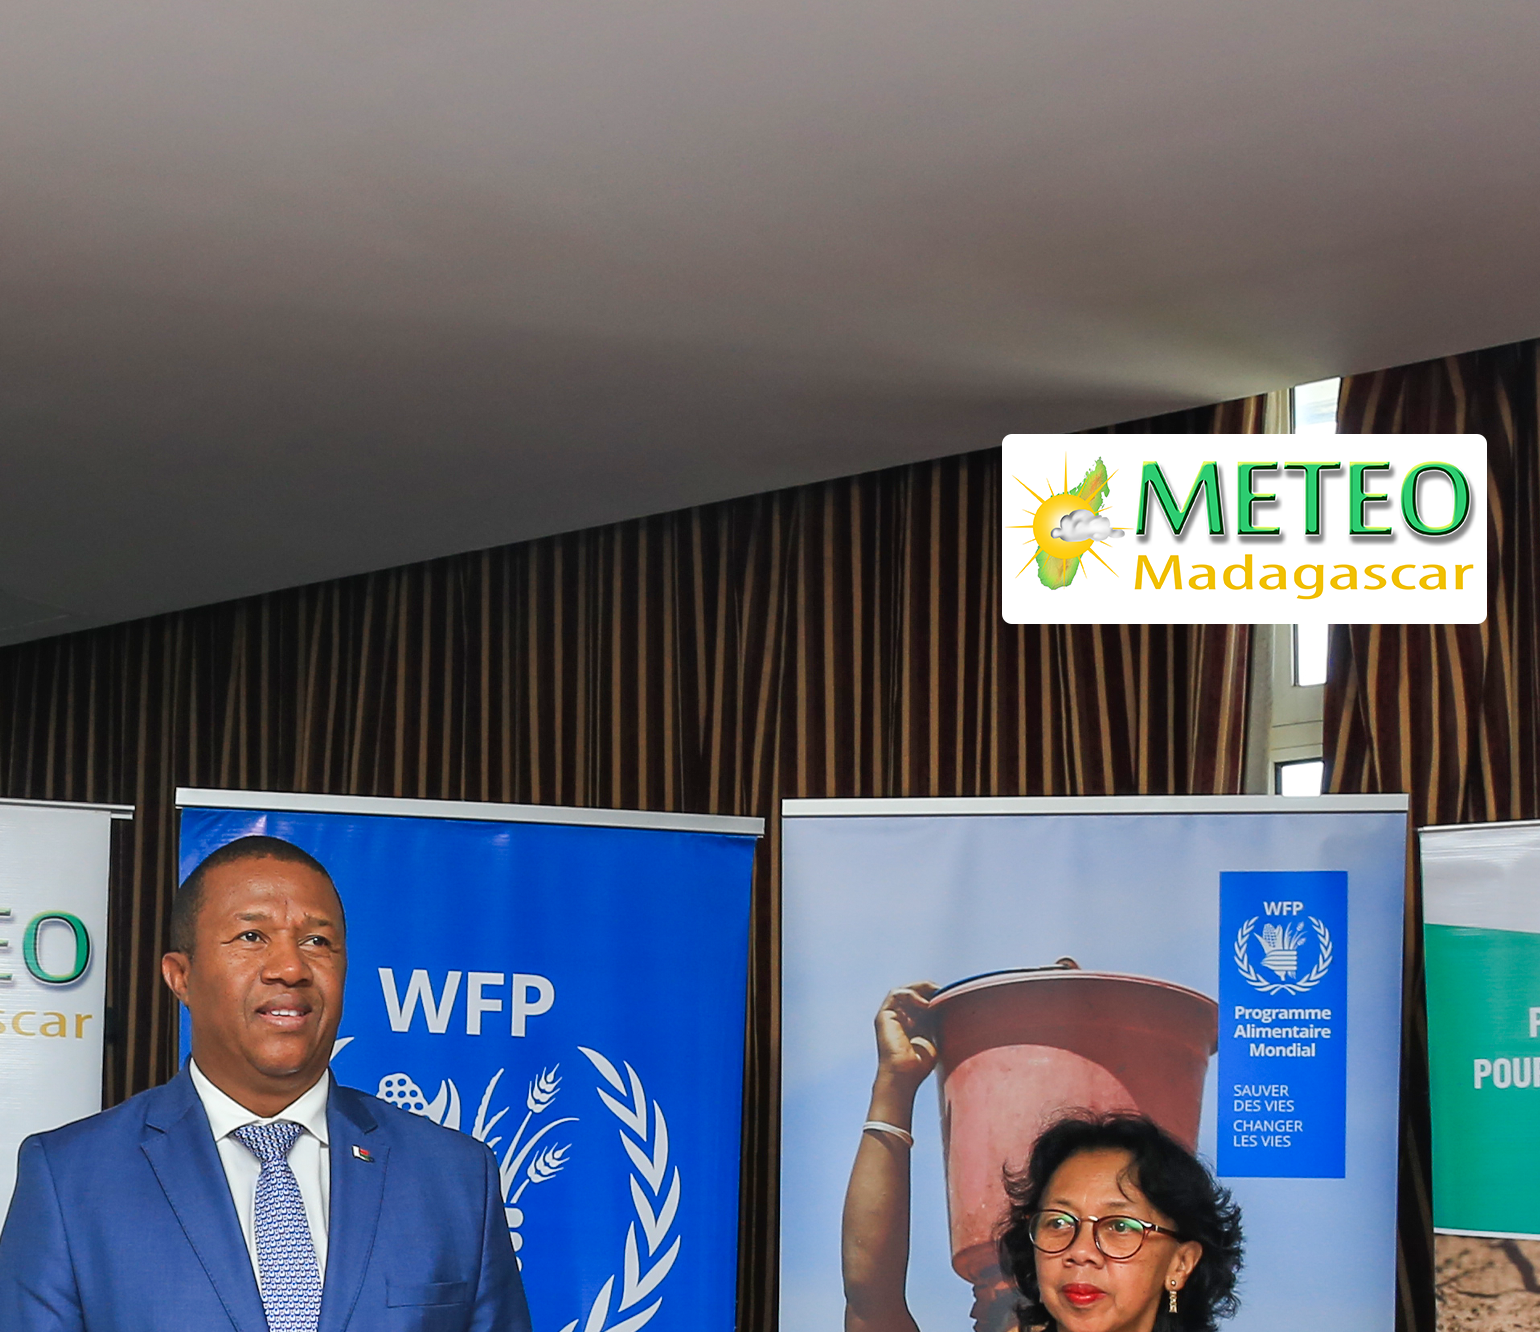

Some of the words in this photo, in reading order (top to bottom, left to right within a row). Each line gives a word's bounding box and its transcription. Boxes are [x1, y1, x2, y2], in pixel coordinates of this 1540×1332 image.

[1263, 901, 1304, 916] WFP
[378, 966, 556, 1038] WFP
[1234, 1006, 1331, 1022] Programme
[1234, 1024, 1331, 1039] Alimentaire
[1249, 1043, 1316, 1057] Mondial
[1234, 1084, 1289, 1097] SAUVER
[1234, 1100, 1262, 1113] DES
[1265, 1100, 1295, 1113] VIES
[1233, 1119, 1303, 1133] CHANGER
[1234, 1135, 1258, 1148] LES
[1261, 1135, 1291, 1148] VIES
